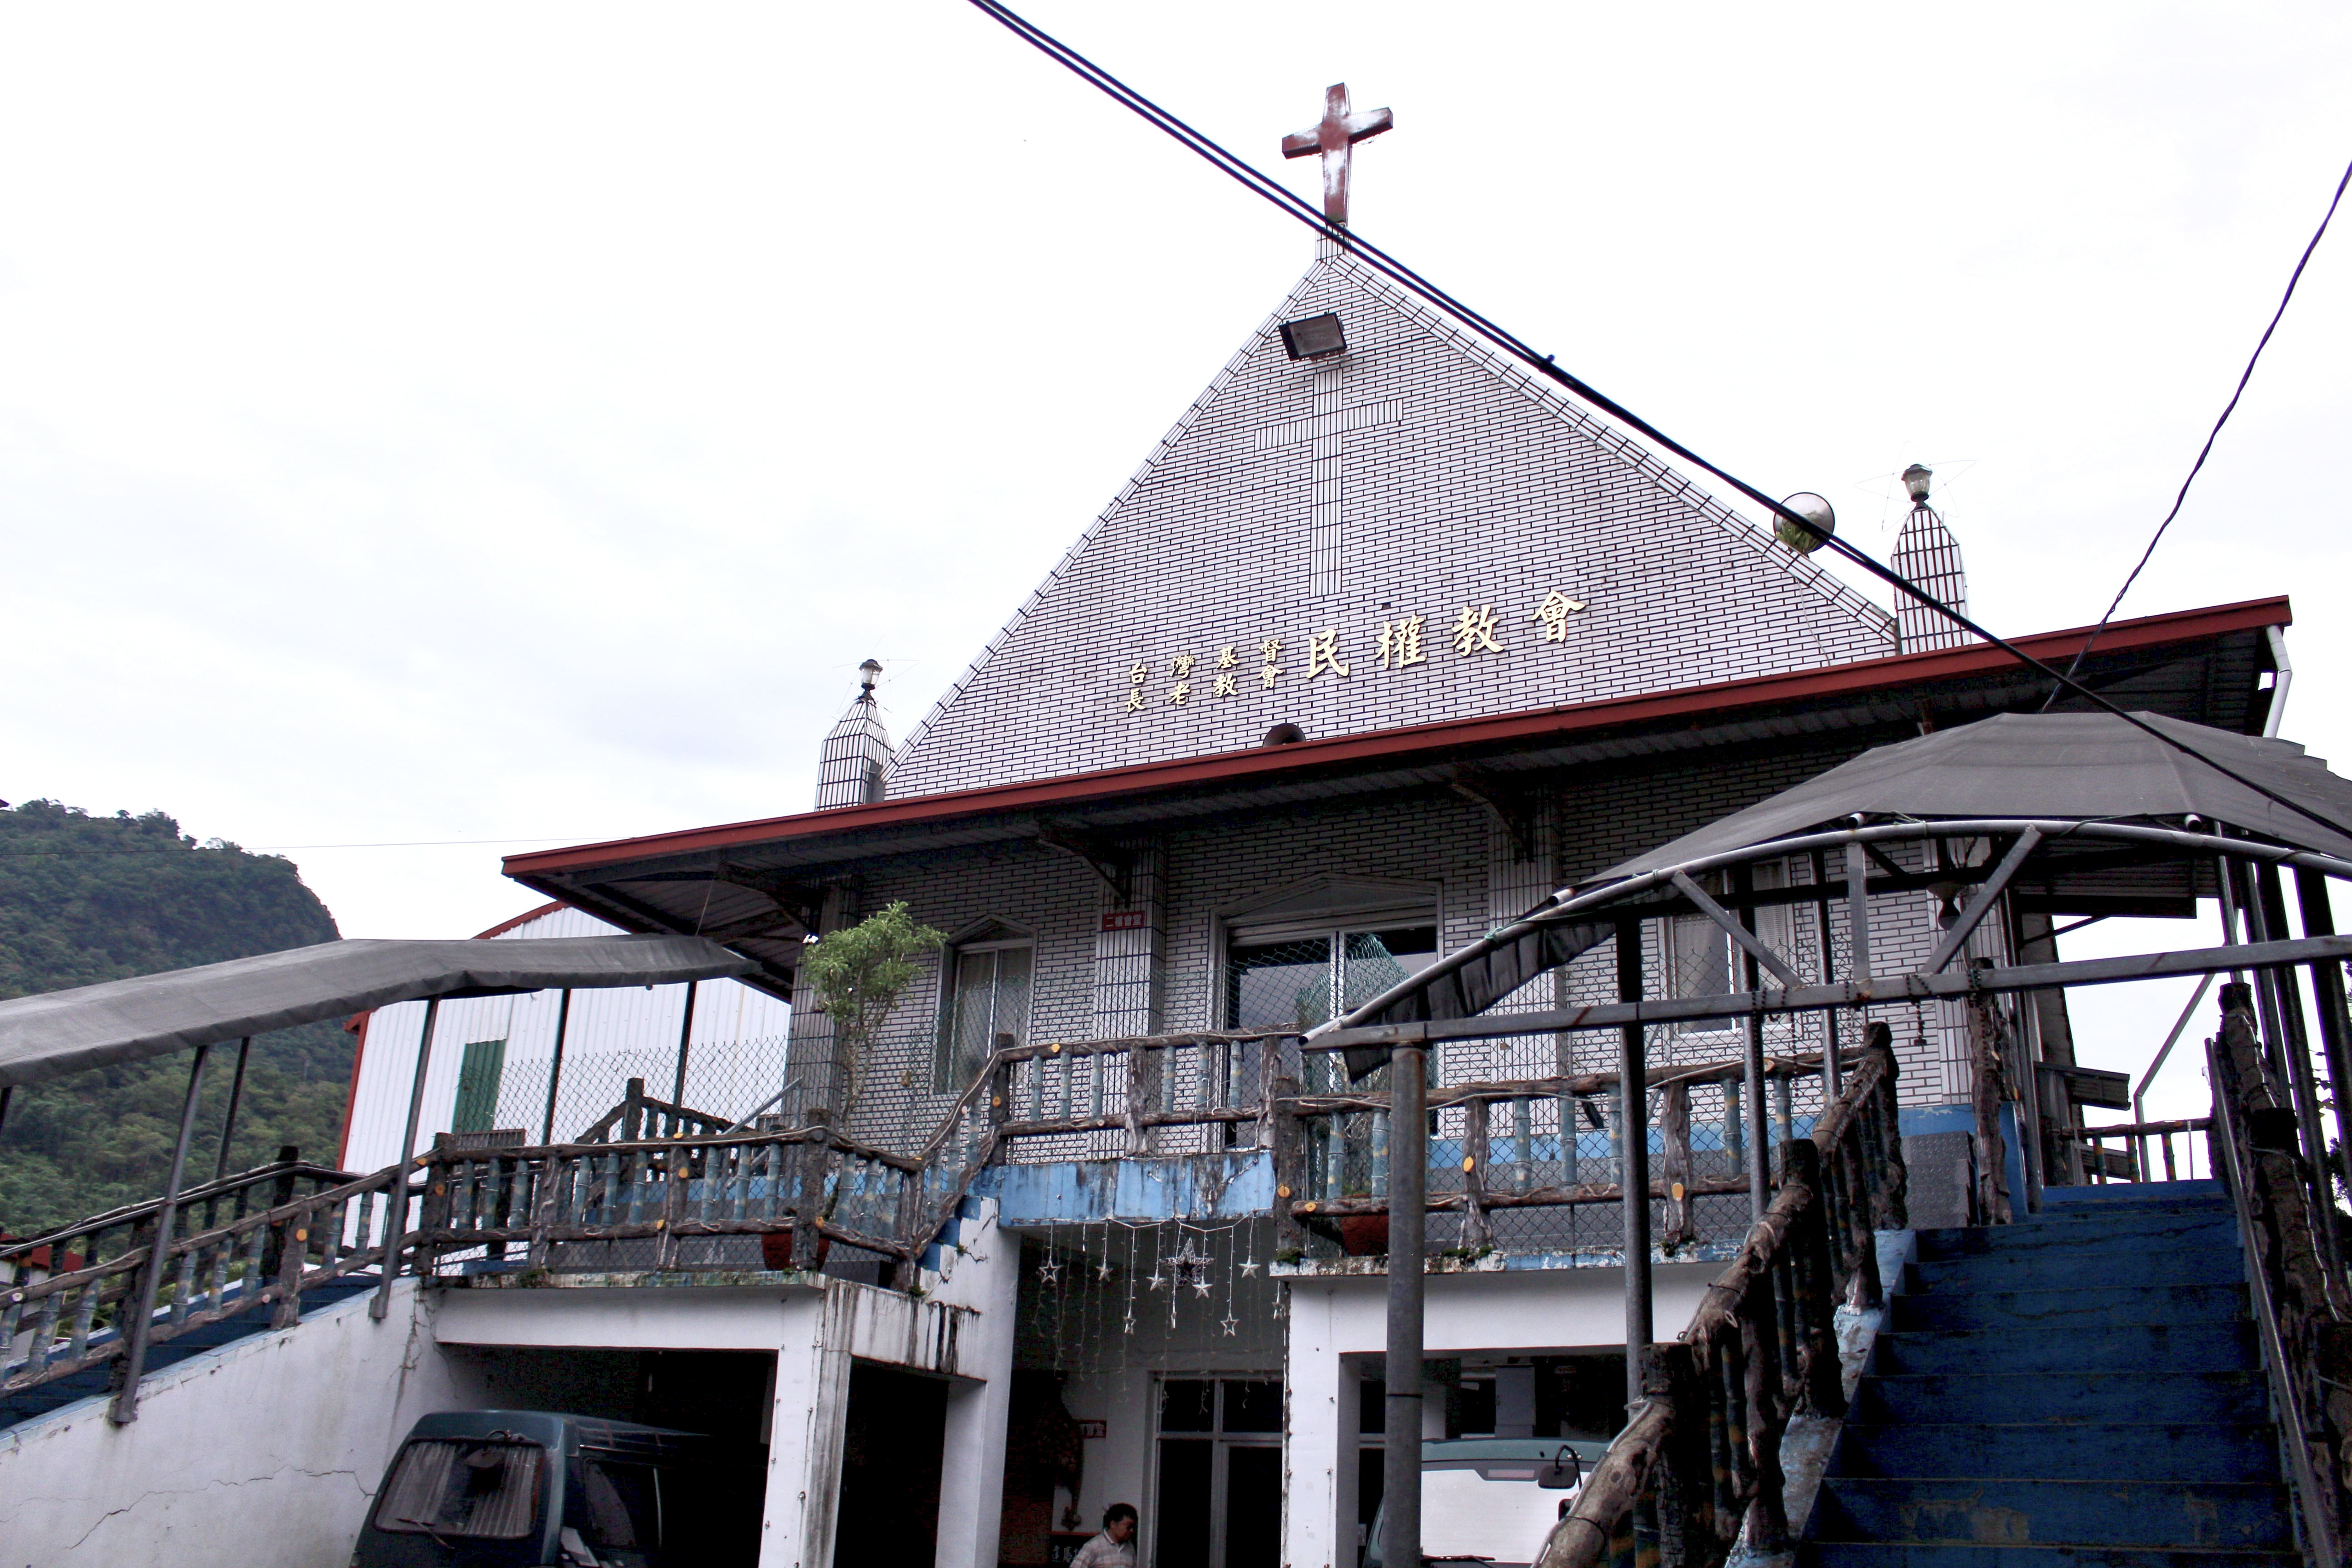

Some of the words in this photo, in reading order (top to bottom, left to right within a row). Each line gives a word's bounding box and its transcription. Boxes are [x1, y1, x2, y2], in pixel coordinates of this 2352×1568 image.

[1306, 591, 1586, 680] 民權教會
[1128, 639, 1284, 685] 台灣基督
[1124, 664, 1284, 713] 長老教會
